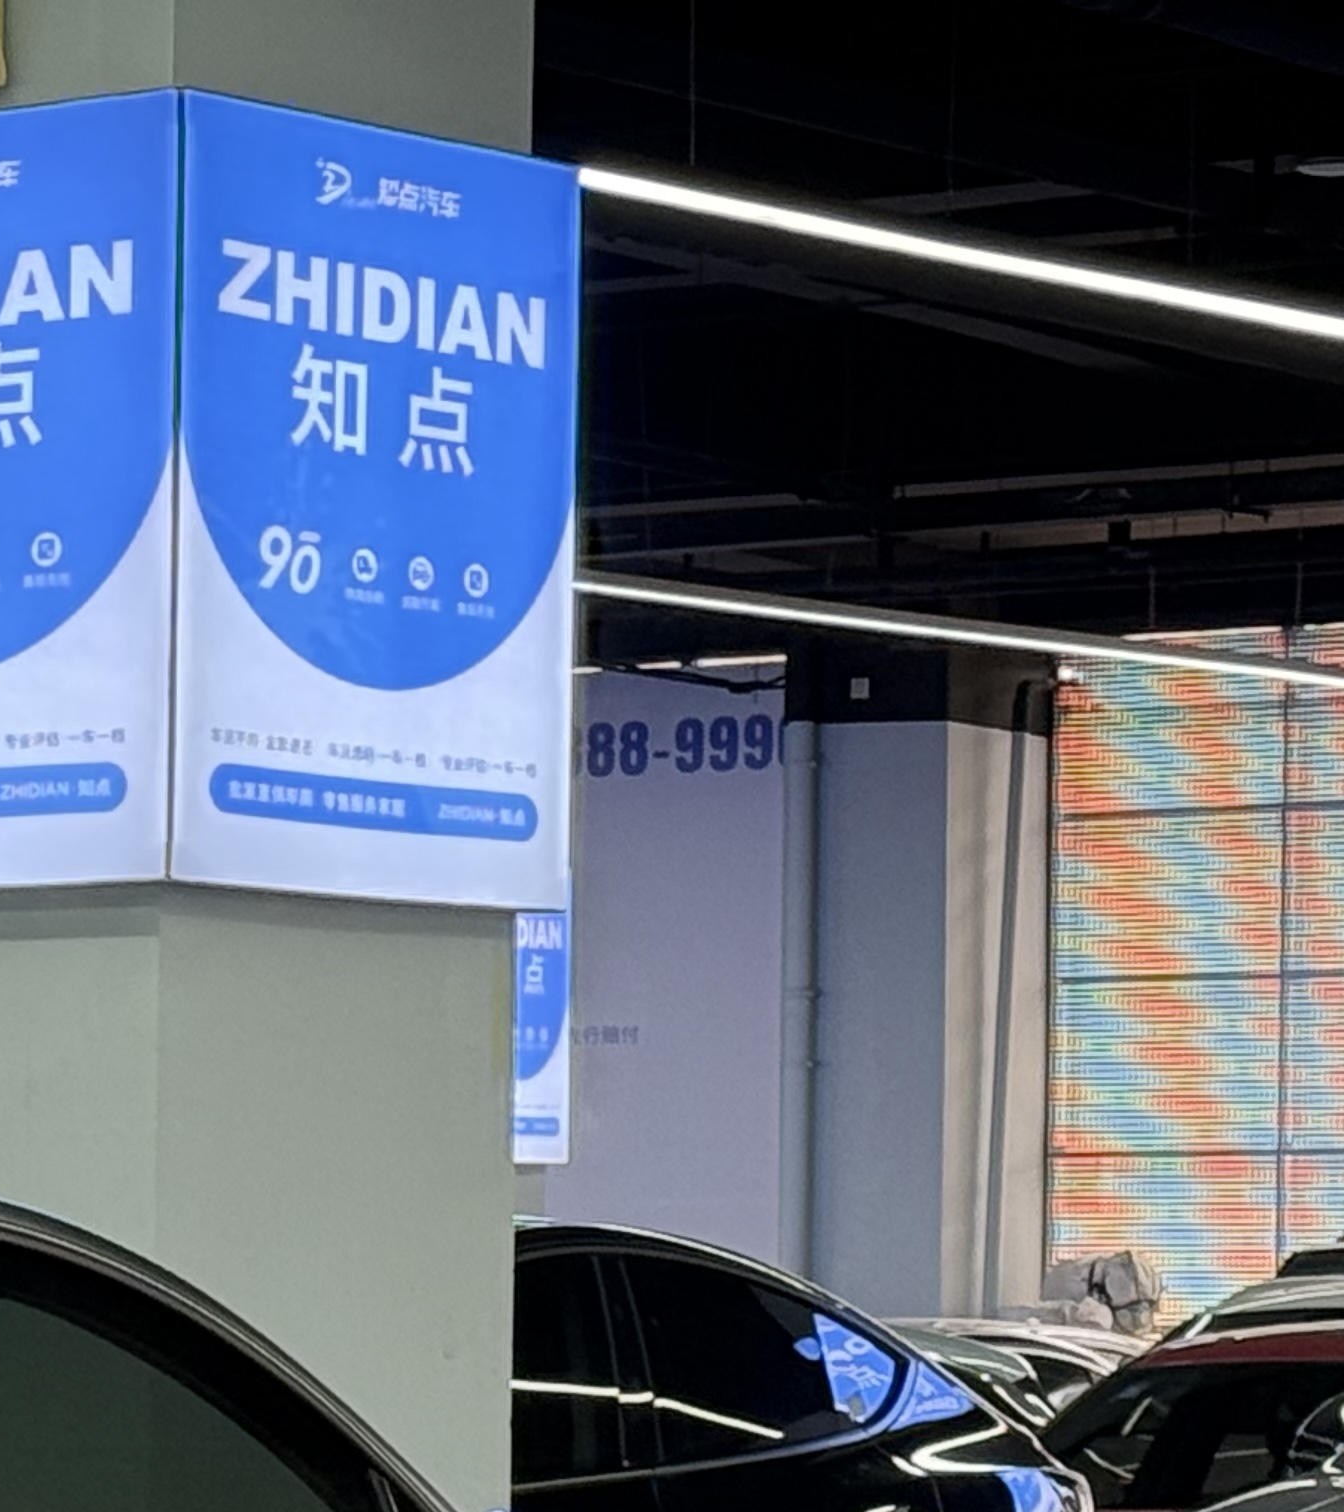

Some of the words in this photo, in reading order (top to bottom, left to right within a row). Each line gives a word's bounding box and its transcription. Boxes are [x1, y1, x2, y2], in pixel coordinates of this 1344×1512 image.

[218, 238, 546, 370] ZHIDIAN
[291, 343, 474, 478] 知点
[576, 714, 784, 777] 88-999
